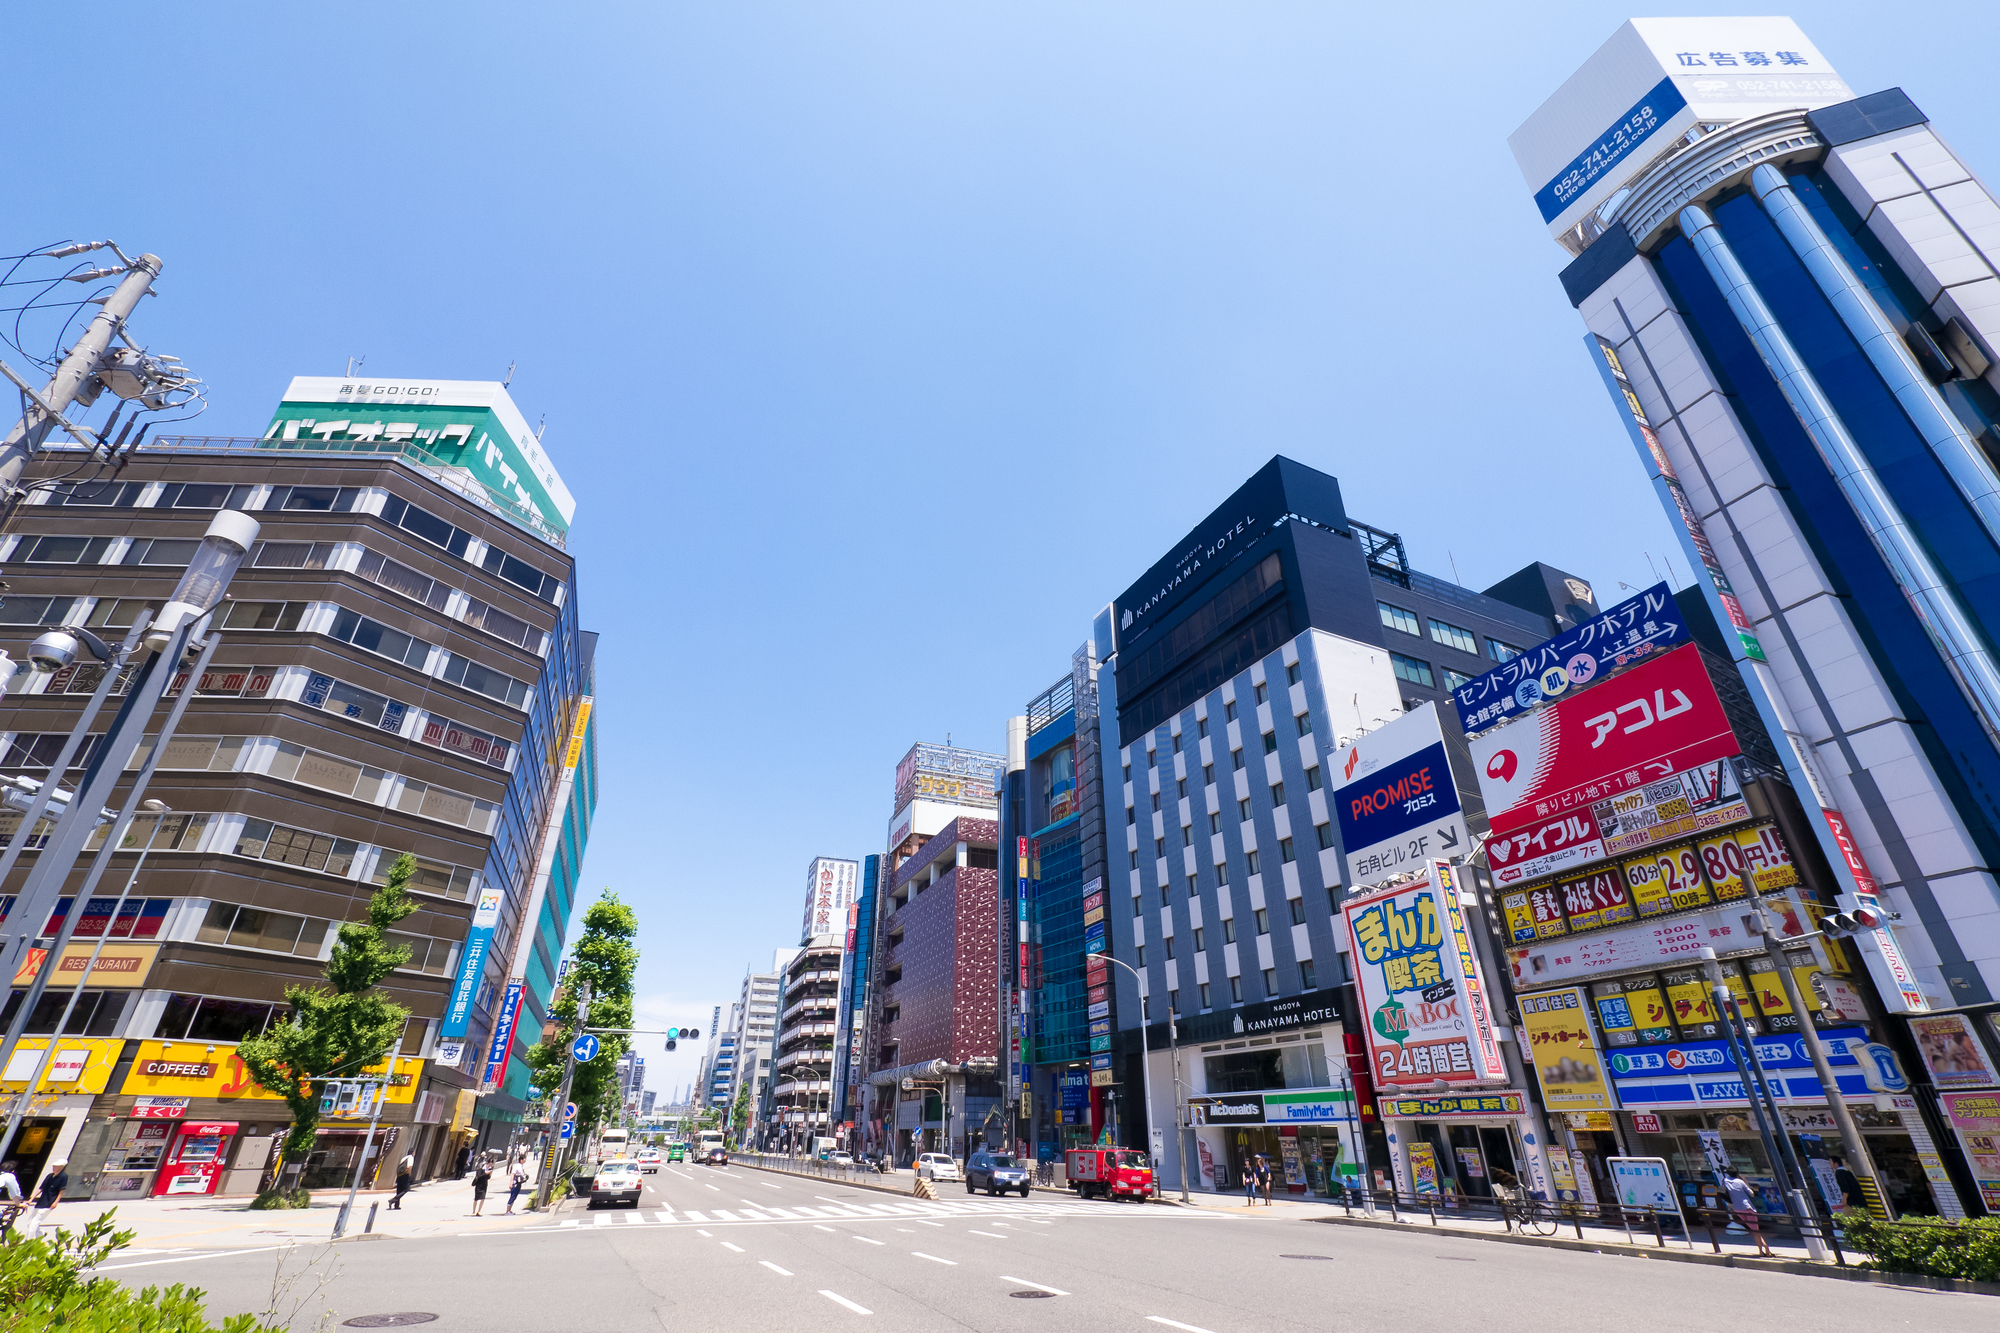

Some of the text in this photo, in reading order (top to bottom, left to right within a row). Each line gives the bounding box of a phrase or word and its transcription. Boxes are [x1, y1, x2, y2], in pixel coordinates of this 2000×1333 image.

[1676, 51, 1809, 67] 広告募集
[1736, 80, 1843, 90] 052-741-2158
[1553, 105, 1654, 197] 052-741-2158
[1559, 115, 1659, 204] info@ad-board.co.jp
[1136, 515, 1256, 618] KANAYAMA HOTEL
[1175, 544, 1203, 568] NAGOYA
[1457, 592, 1666, 707] セントラルパークホテル
[1601, 620, 1660, 658] 人工温泉
[1614, 642, 1654, 667] 南へ3分
[1465, 695, 1516, 728] 全館完備
[1584, 688, 1693, 749] アコム
[920, 775, 963, 797] サウナ
[1351, 767, 1433, 821] PROMISE
[1403, 792, 1437, 815] プロミス
[1511, 815, 1591, 858] アイフル
[1830, 818, 1864, 870] アコム
[1356, 835, 1429, 878] 右角ビル 2F
[1523, 845, 1597, 870] ニューズ金山ビル 7F
[1525, 864, 1552, 877] 左角ビル
[1628, 864, 1660, 886] 60分
[1767, 874, 1799, 888] 22:30)
[816, 868, 834, 925] かに本家
[1716, 881, 1745, 898] 23:3
[1506, 894, 1525, 908] りらく
[1438, 866, 1476, 977] まんが喫茶
[1708, 926, 1732, 939] 美容
[1523, 929, 1533, 937] 3F
[1582, 932, 1697, 960] カット 1500
[65, 959, 137, 970] RESAURANT
[1383, 951, 1444, 991] 喫茶
[1554, 955, 1572, 967] 美容
[1583, 957, 1619, 967] ヘアカラー
[1624, 979, 1656, 990] マンション
[1751, 961, 1777, 972] 事務
[1791, 953, 1816, 967] 店舗
[451, 938, 485, 1024] 三井住友信託銀行
[1273, 1001, 1301, 1012] NAGOYA
[1523, 994, 1578, 1014] 賃貸住宅
[1901, 991, 1922, 1008] 7F
[494, 986, 520, 1060] アートネイチャー
[1247, 1007, 1340, 1032] KANAYAMA HOTEL
[1531, 1028, 1589, 1046] シティホーム
[1617, 1032, 1638, 1044] 金山
[1631, 1054, 1660, 1069] 野菜
[1685, 1048, 1722, 1066] くだもの
[134, 1106, 182, 1118] 宝くじ
[1210, 1103, 1261, 1117] McDonald's
[1286, 1104, 1336, 1119] FamilyMart
[1398, 1097, 1502, 1116] まんが喫茶
[1954, 1097, 1999, 1109] 女性無料
[1638, 1123, 1658, 1131] ATM
[1618, 1166, 1660, 1177] 金山四丁目
